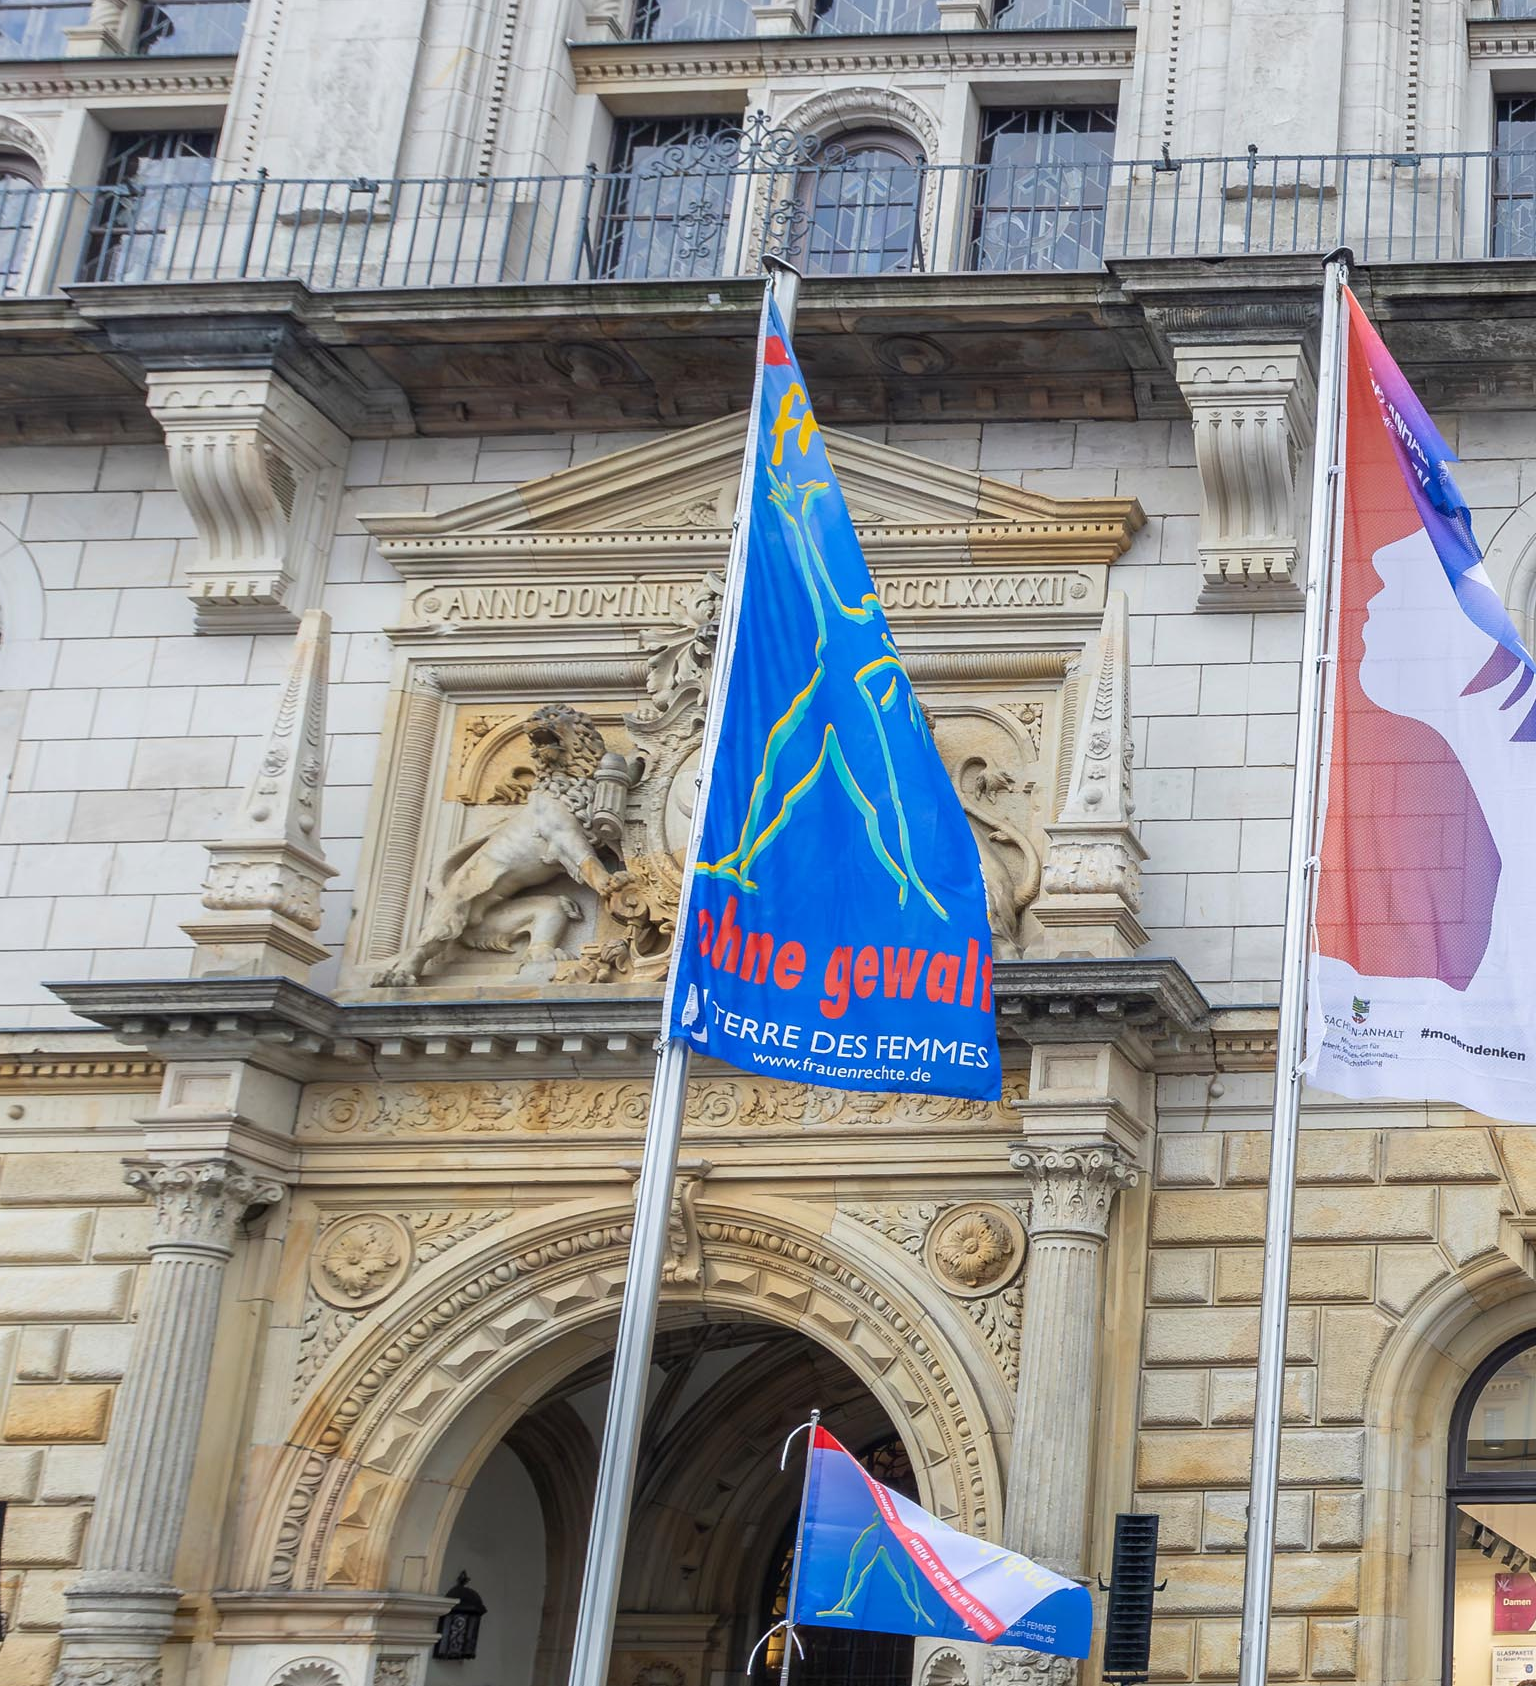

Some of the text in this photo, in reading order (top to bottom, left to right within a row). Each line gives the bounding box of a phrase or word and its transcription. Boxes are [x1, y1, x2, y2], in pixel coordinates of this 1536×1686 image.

[697, 895, 807, 990] ohne
[712, 1000, 801, 1049] TERRE
[810, 1030, 867, 1059] DES
[876, 1034, 990, 1069] FEMMES
[1420, 1027, 1526, 1062] #moderndenken
[752, 1051, 931, 1083] www.frauenrechte.de
[1503, 1597, 1531, 1606] Damen
[1026, 1620, 1057, 1634] FEMMES
